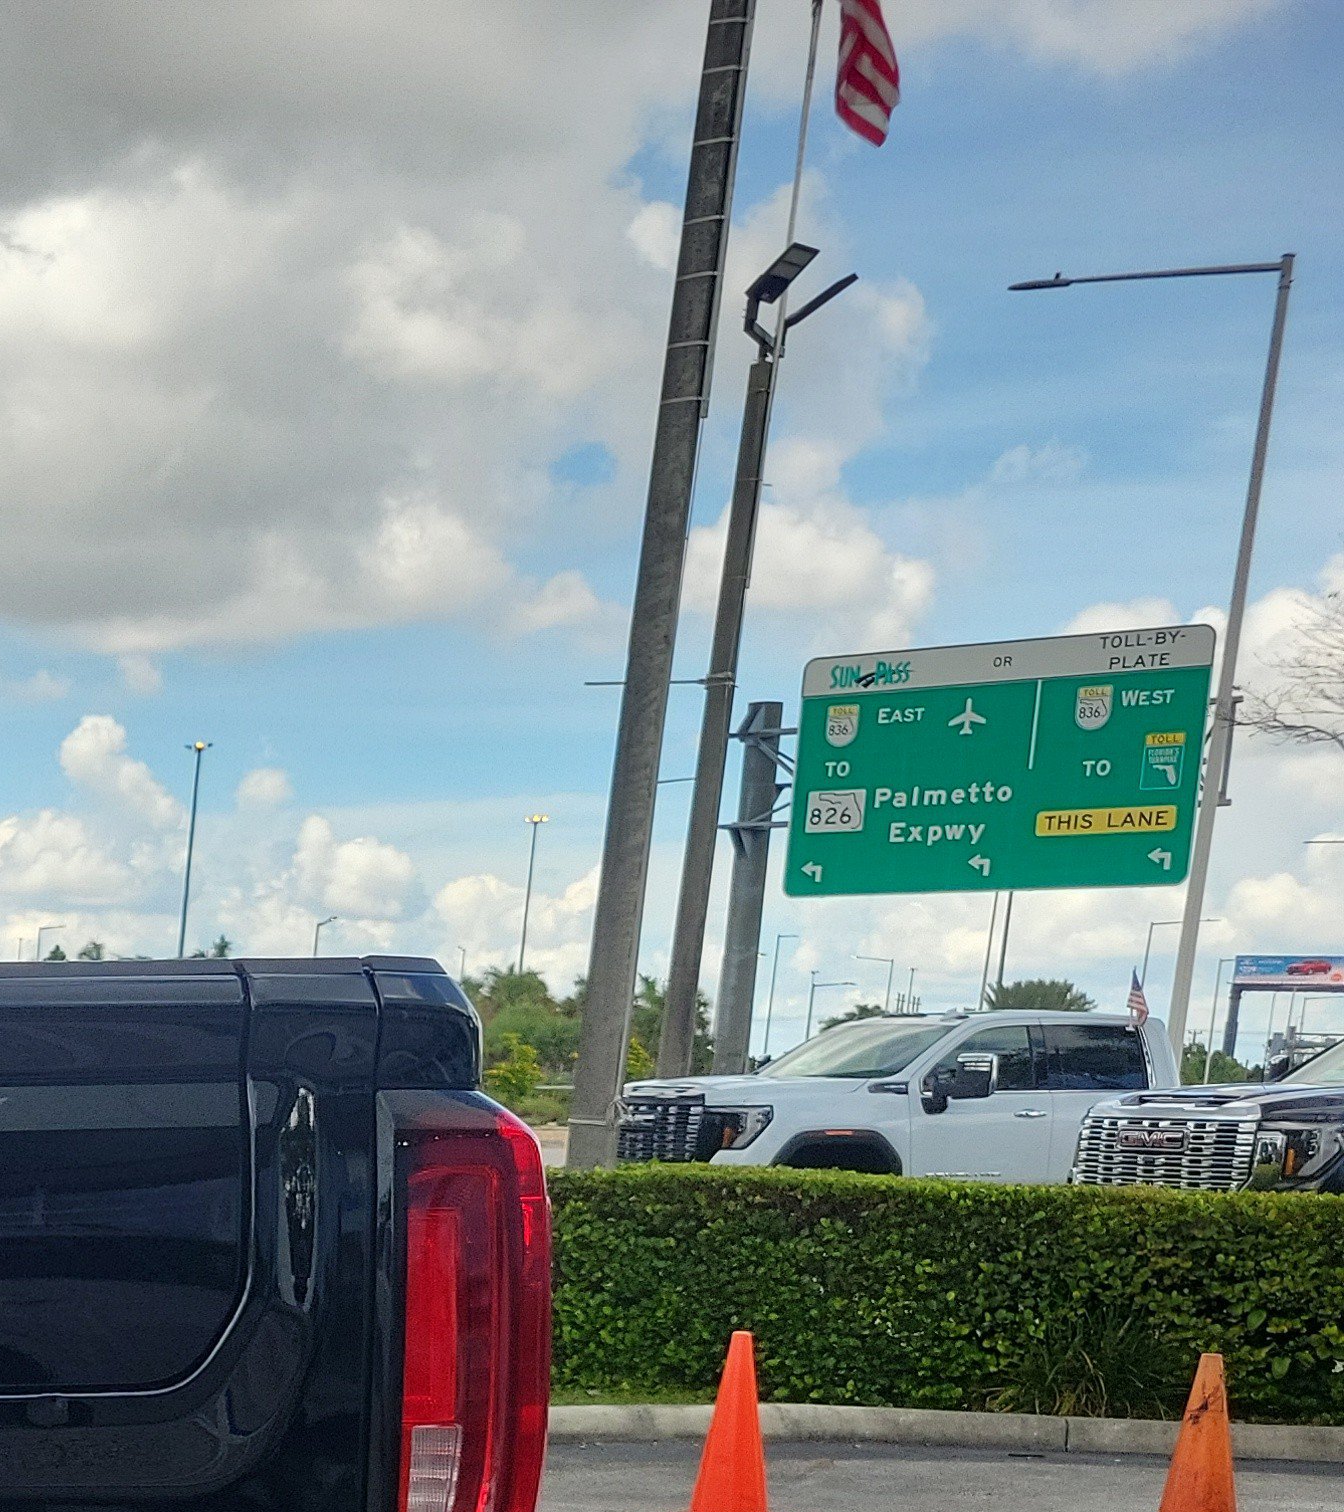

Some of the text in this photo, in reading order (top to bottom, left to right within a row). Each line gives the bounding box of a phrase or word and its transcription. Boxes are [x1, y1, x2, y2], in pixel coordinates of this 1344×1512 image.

[993, 656, 1013, 668] OR
[1108, 652, 1170, 670] PLATE
[1082, 688, 1106, 697] TOLL
[1121, 689, 1175, 707] WEST
[877, 707, 925, 724] EAST
[1078, 706, 1101, 719] 836
[828, 724, 849, 736] 836
[1151, 734, 1179, 744] TOLL
[825, 761, 851, 777] TO
[1082, 760, 1112, 777] TO
[873, 781, 1013, 808] Palmetto
[809, 807, 852, 826] 826
[1044, 810, 1169, 831] THIS LANE
[889, 822, 985, 846] Expwy
[1119, 1130, 1184, 1148] GMC
